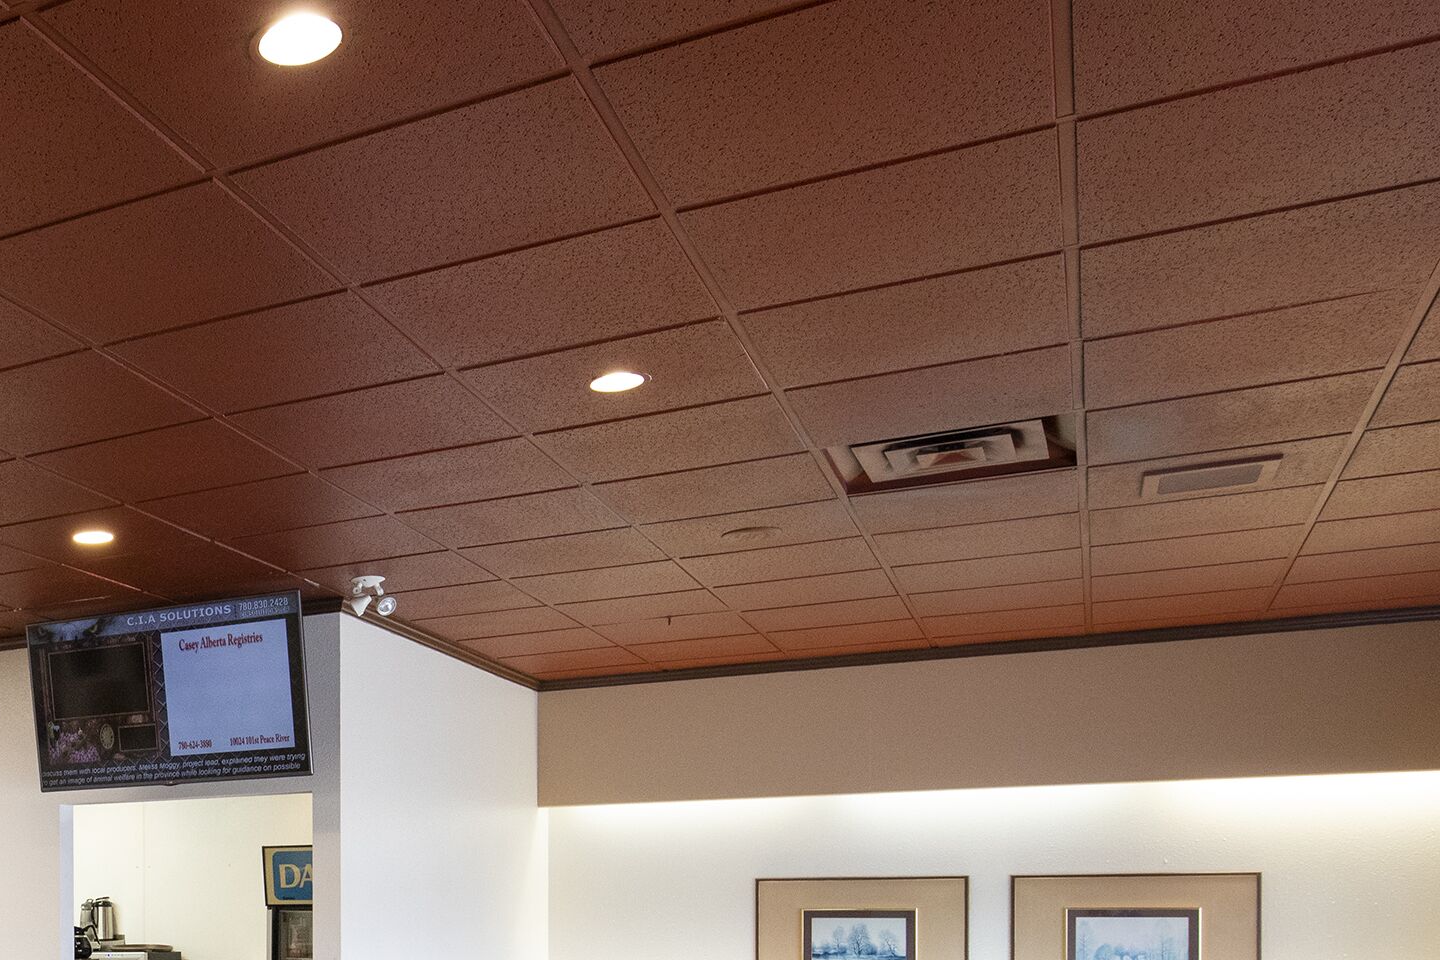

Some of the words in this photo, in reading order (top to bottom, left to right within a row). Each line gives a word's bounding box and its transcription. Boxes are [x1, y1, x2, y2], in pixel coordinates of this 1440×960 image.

[160, 604, 232, 622] SOLUTIONS
[178, 638, 199, 654] Casey
[200, 635, 227, 649] Alberta
[228, 632, 263, 650] Registries
[260, 735, 275, 744] Peace
[275, 734, 290, 743] River
[182, 760, 204, 768] project
[221, 755, 253, 766] explained
[254, 755, 268, 763] they
[287, 753, 306, 761] trying
[198, 766, 221, 776] looking
[222, 766, 231, 774] for
[232, 764, 262, 774] guidance
[273, 762, 301, 772] possible
